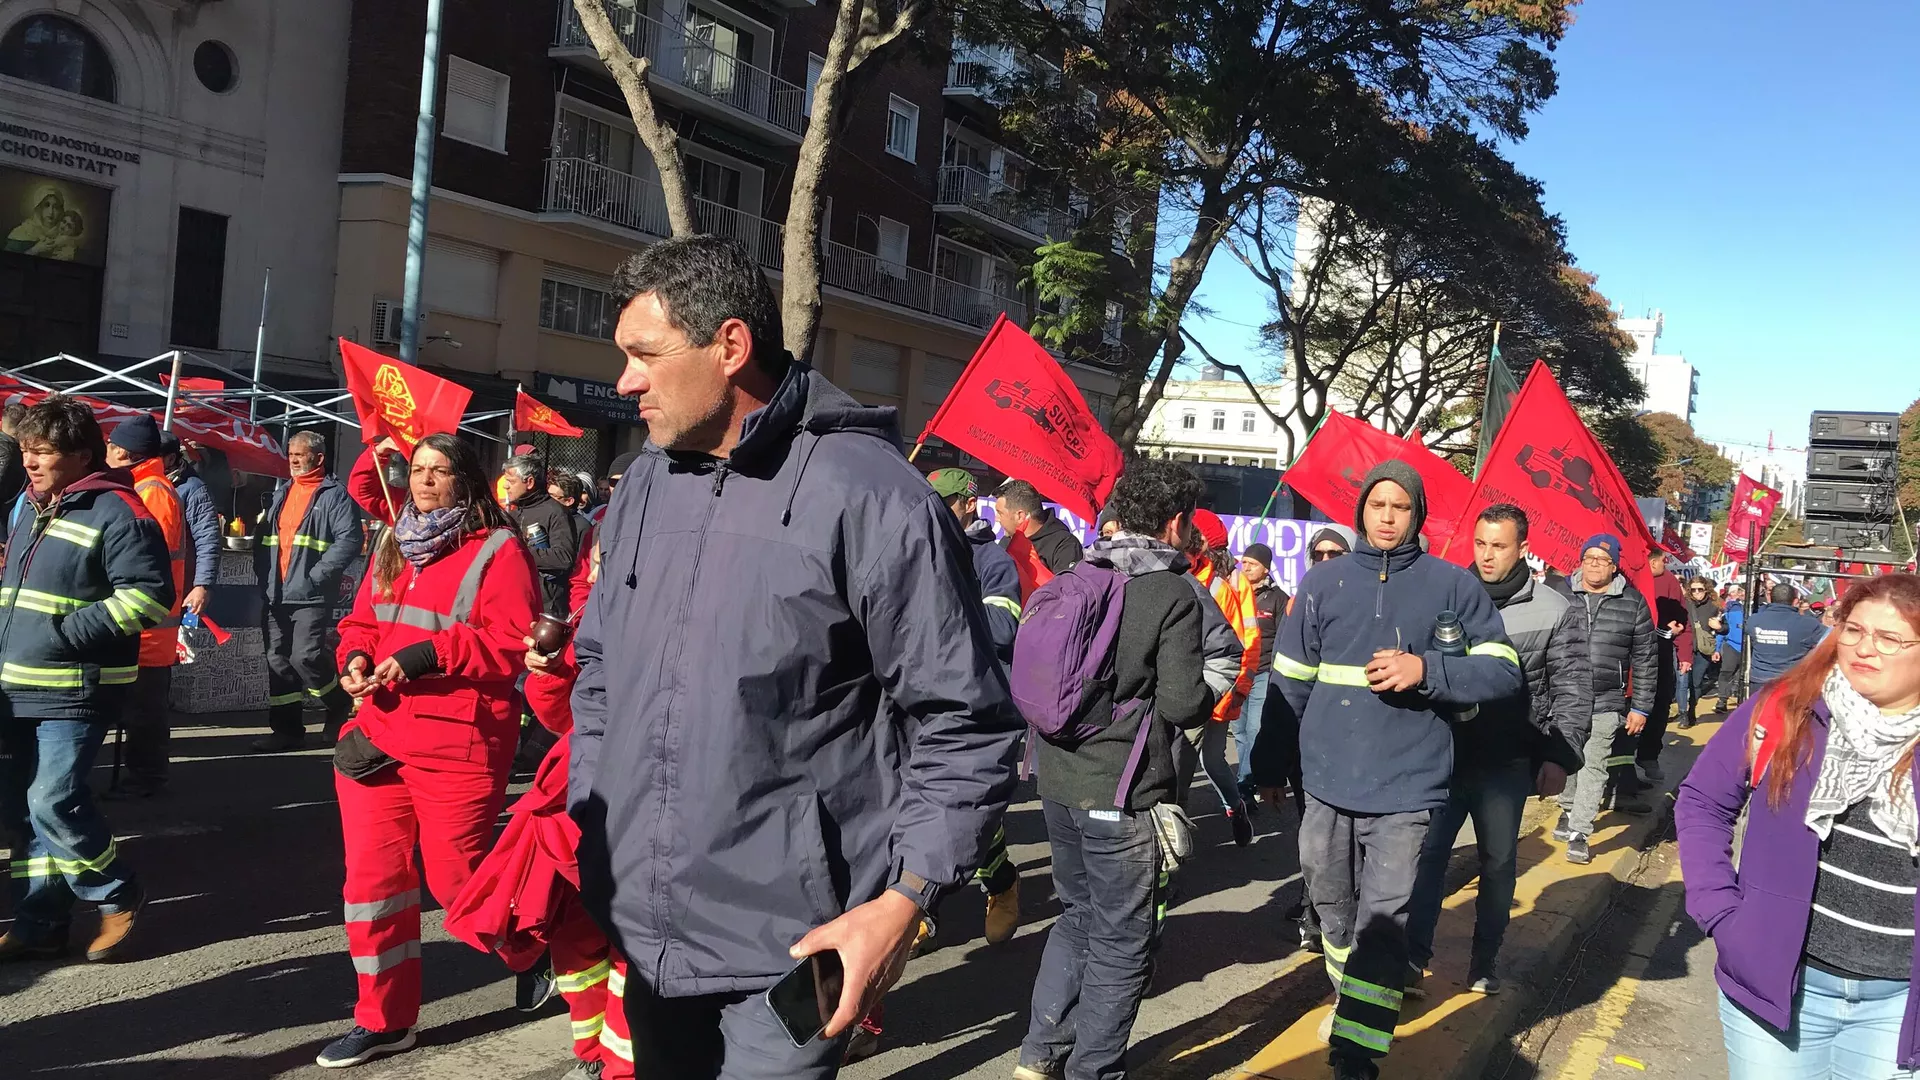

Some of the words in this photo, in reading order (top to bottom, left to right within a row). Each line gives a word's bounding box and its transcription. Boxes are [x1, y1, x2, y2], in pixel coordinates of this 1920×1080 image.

[0, 139, 117, 176] CHOENSTATT
[50, 134, 123, 160] APOSTÓLICO
[124, 152, 140, 165] DE
[966, 424, 996, 447] SINDICATO
[1020, 449, 1055, 476] TRANSPORTE
[1050, 404, 1085, 455] SUTCRA
